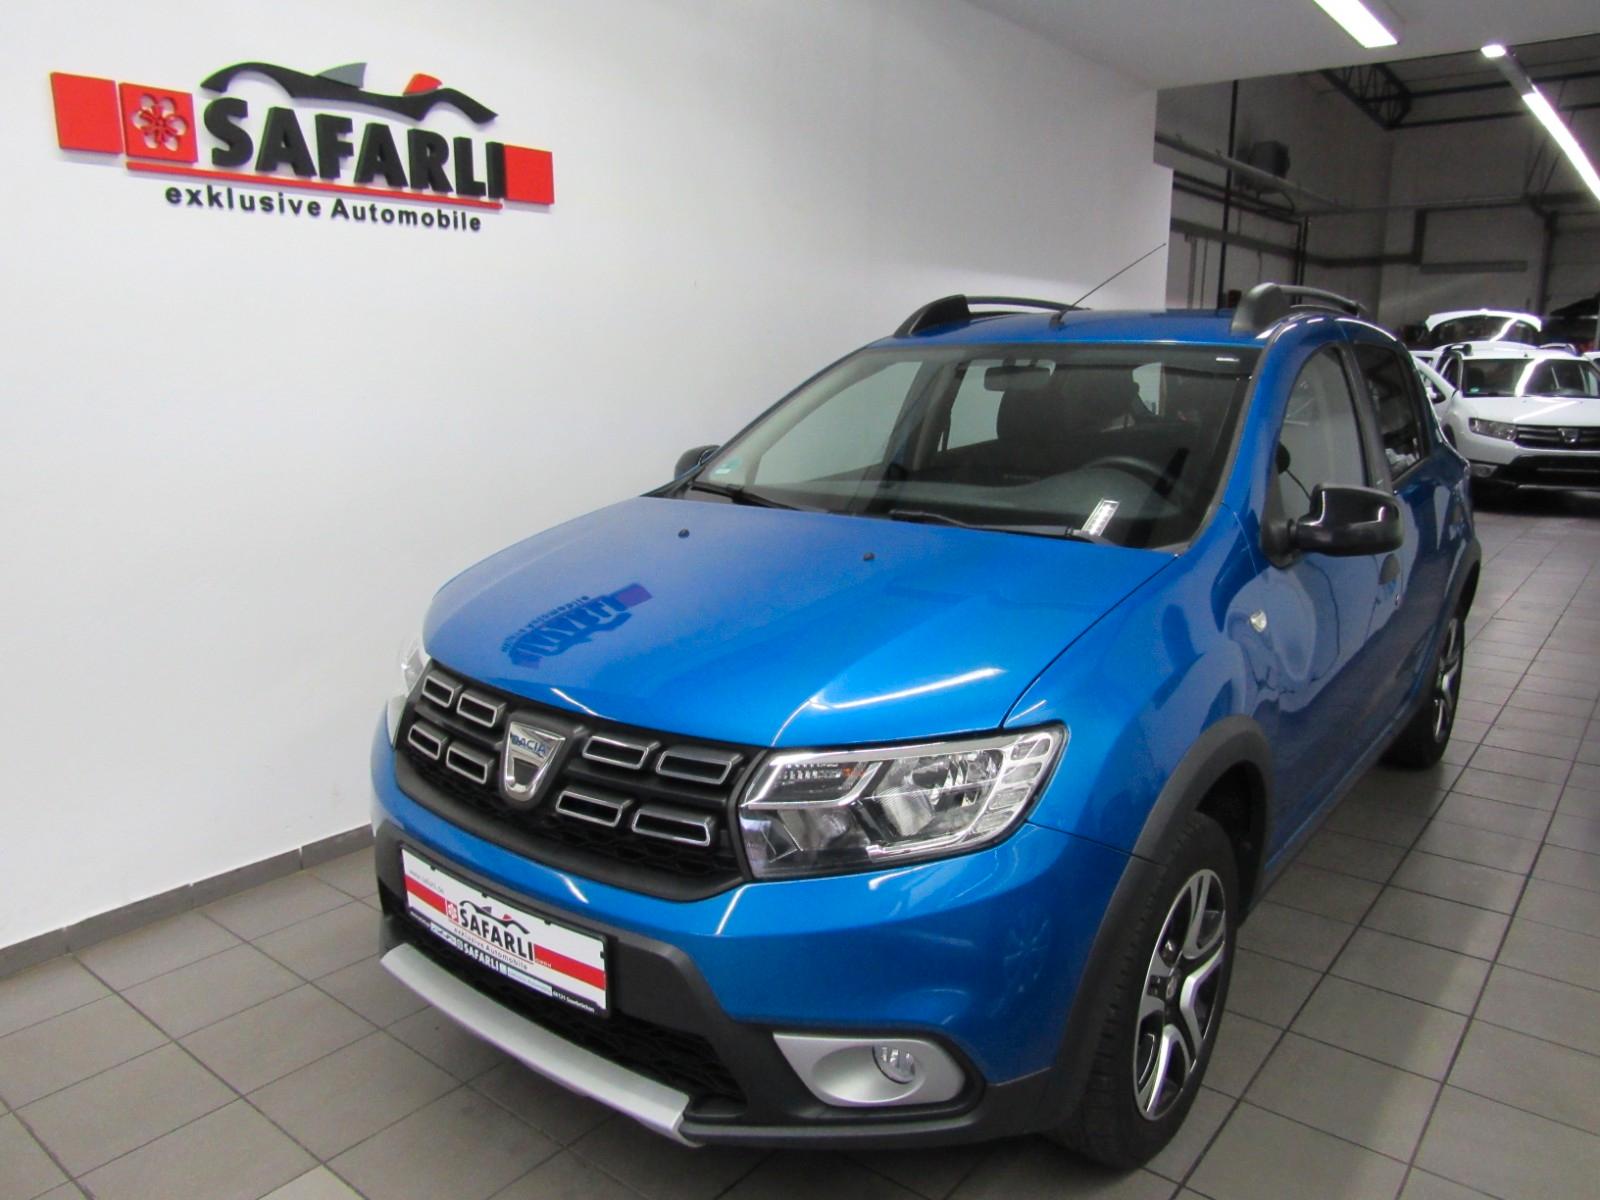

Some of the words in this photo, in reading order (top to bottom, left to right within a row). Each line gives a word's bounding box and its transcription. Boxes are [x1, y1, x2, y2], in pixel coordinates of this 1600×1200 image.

[203, 97, 505, 200] SAFARLI
[165, 183, 322, 217] exklusive
[331, 199, 482, 232] Automobile
[511, 735, 546, 754] DACIA
[459, 909, 534, 962] SAFARLI
[463, 942, 499, 972] SAFARLI
